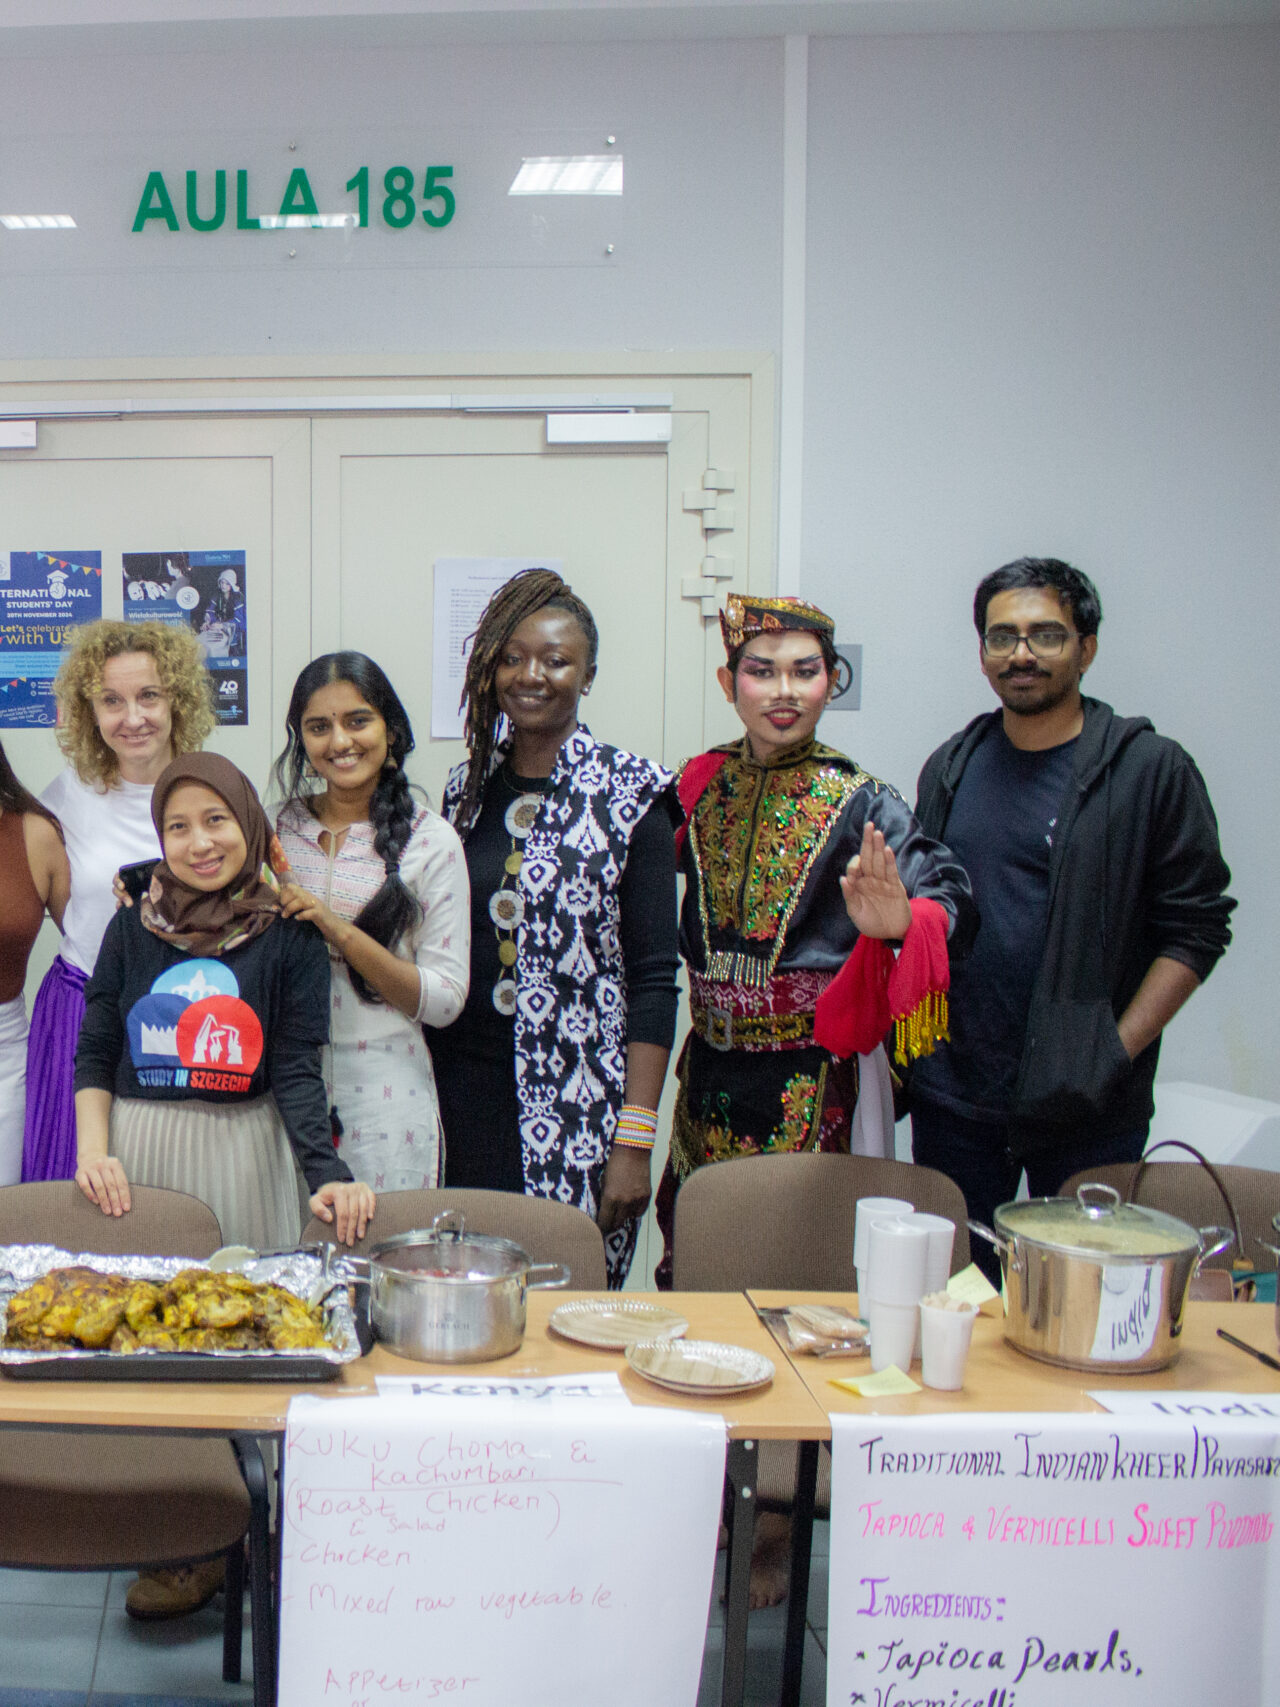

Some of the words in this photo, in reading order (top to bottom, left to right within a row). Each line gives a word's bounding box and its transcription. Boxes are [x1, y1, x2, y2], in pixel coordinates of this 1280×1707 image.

[132, 168, 322, 232] AULA
[345, 165, 457, 229] 185
[5, 631, 44, 645] with
[136, 1069, 173, 1087] STUDY
[175, 1069, 189, 1087] IN
[190, 1071, 252, 1092] SZCZECIN
[411, 1383, 597, 1399] Kenya
[309, 1583, 396, 1617] Mixed
[415, 1595, 457, 1613] raw
